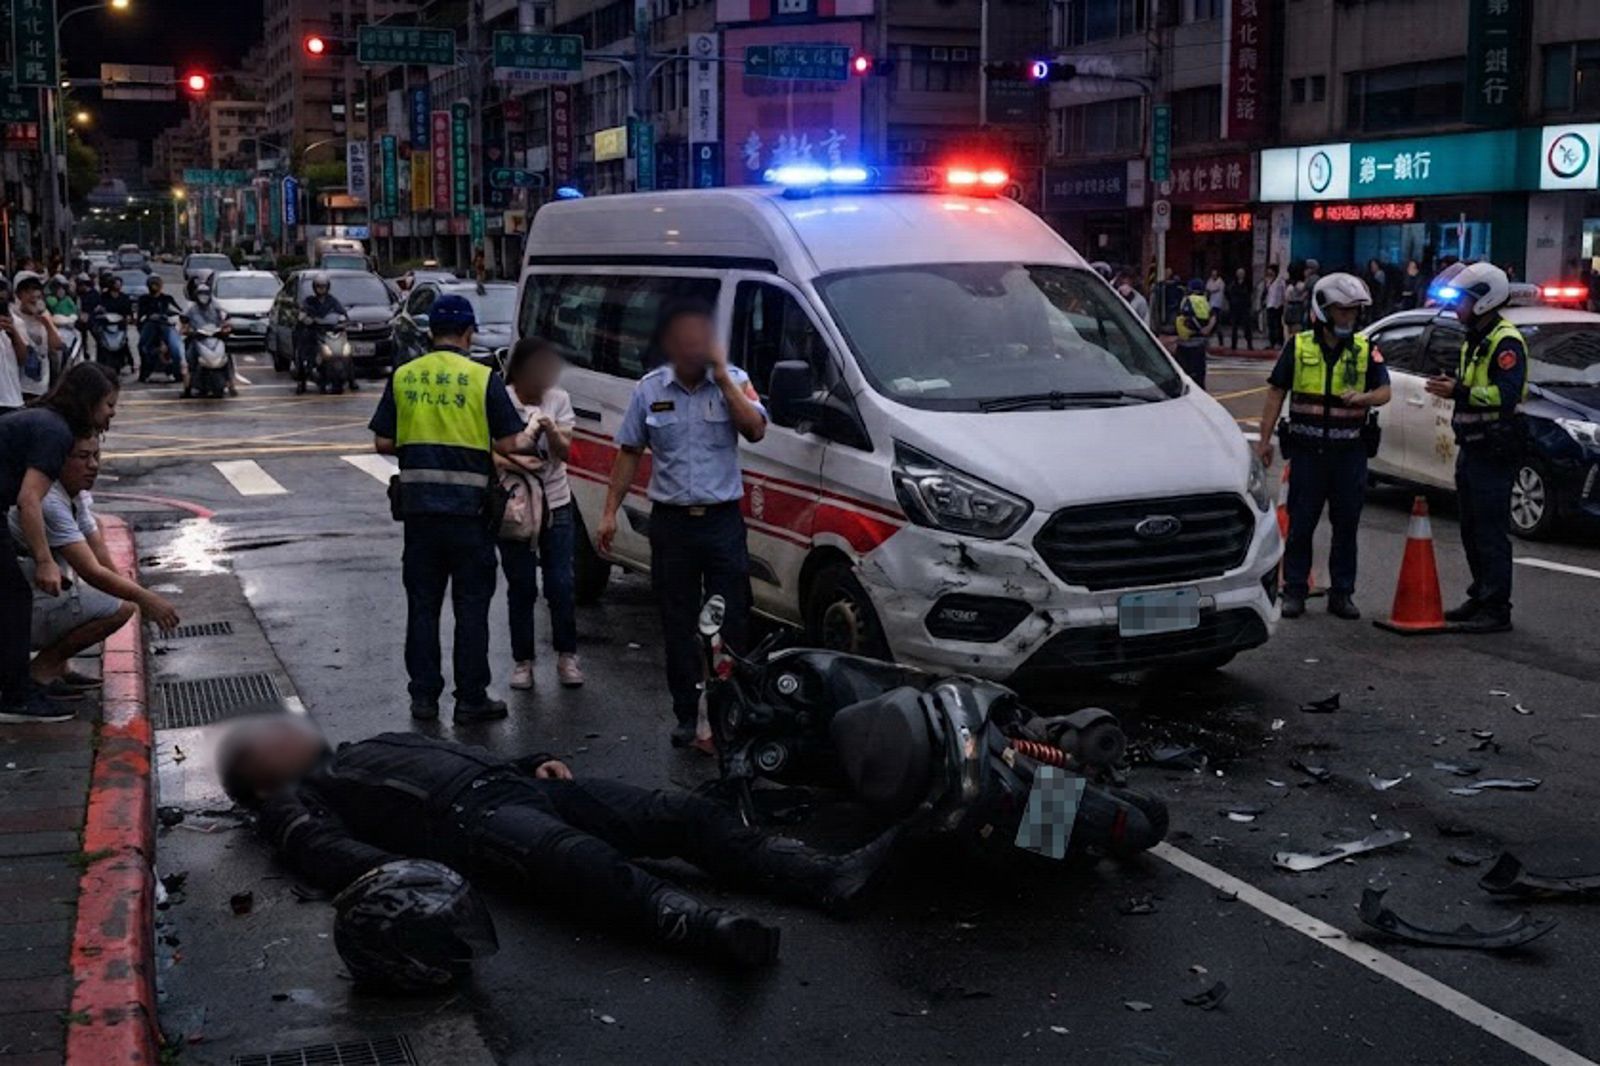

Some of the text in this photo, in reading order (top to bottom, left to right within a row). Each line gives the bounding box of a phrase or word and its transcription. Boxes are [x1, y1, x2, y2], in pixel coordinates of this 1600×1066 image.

[1482, 0, 1509, 104] 第一銀行
[1358, 151, 1431, 184] 第一銀行
